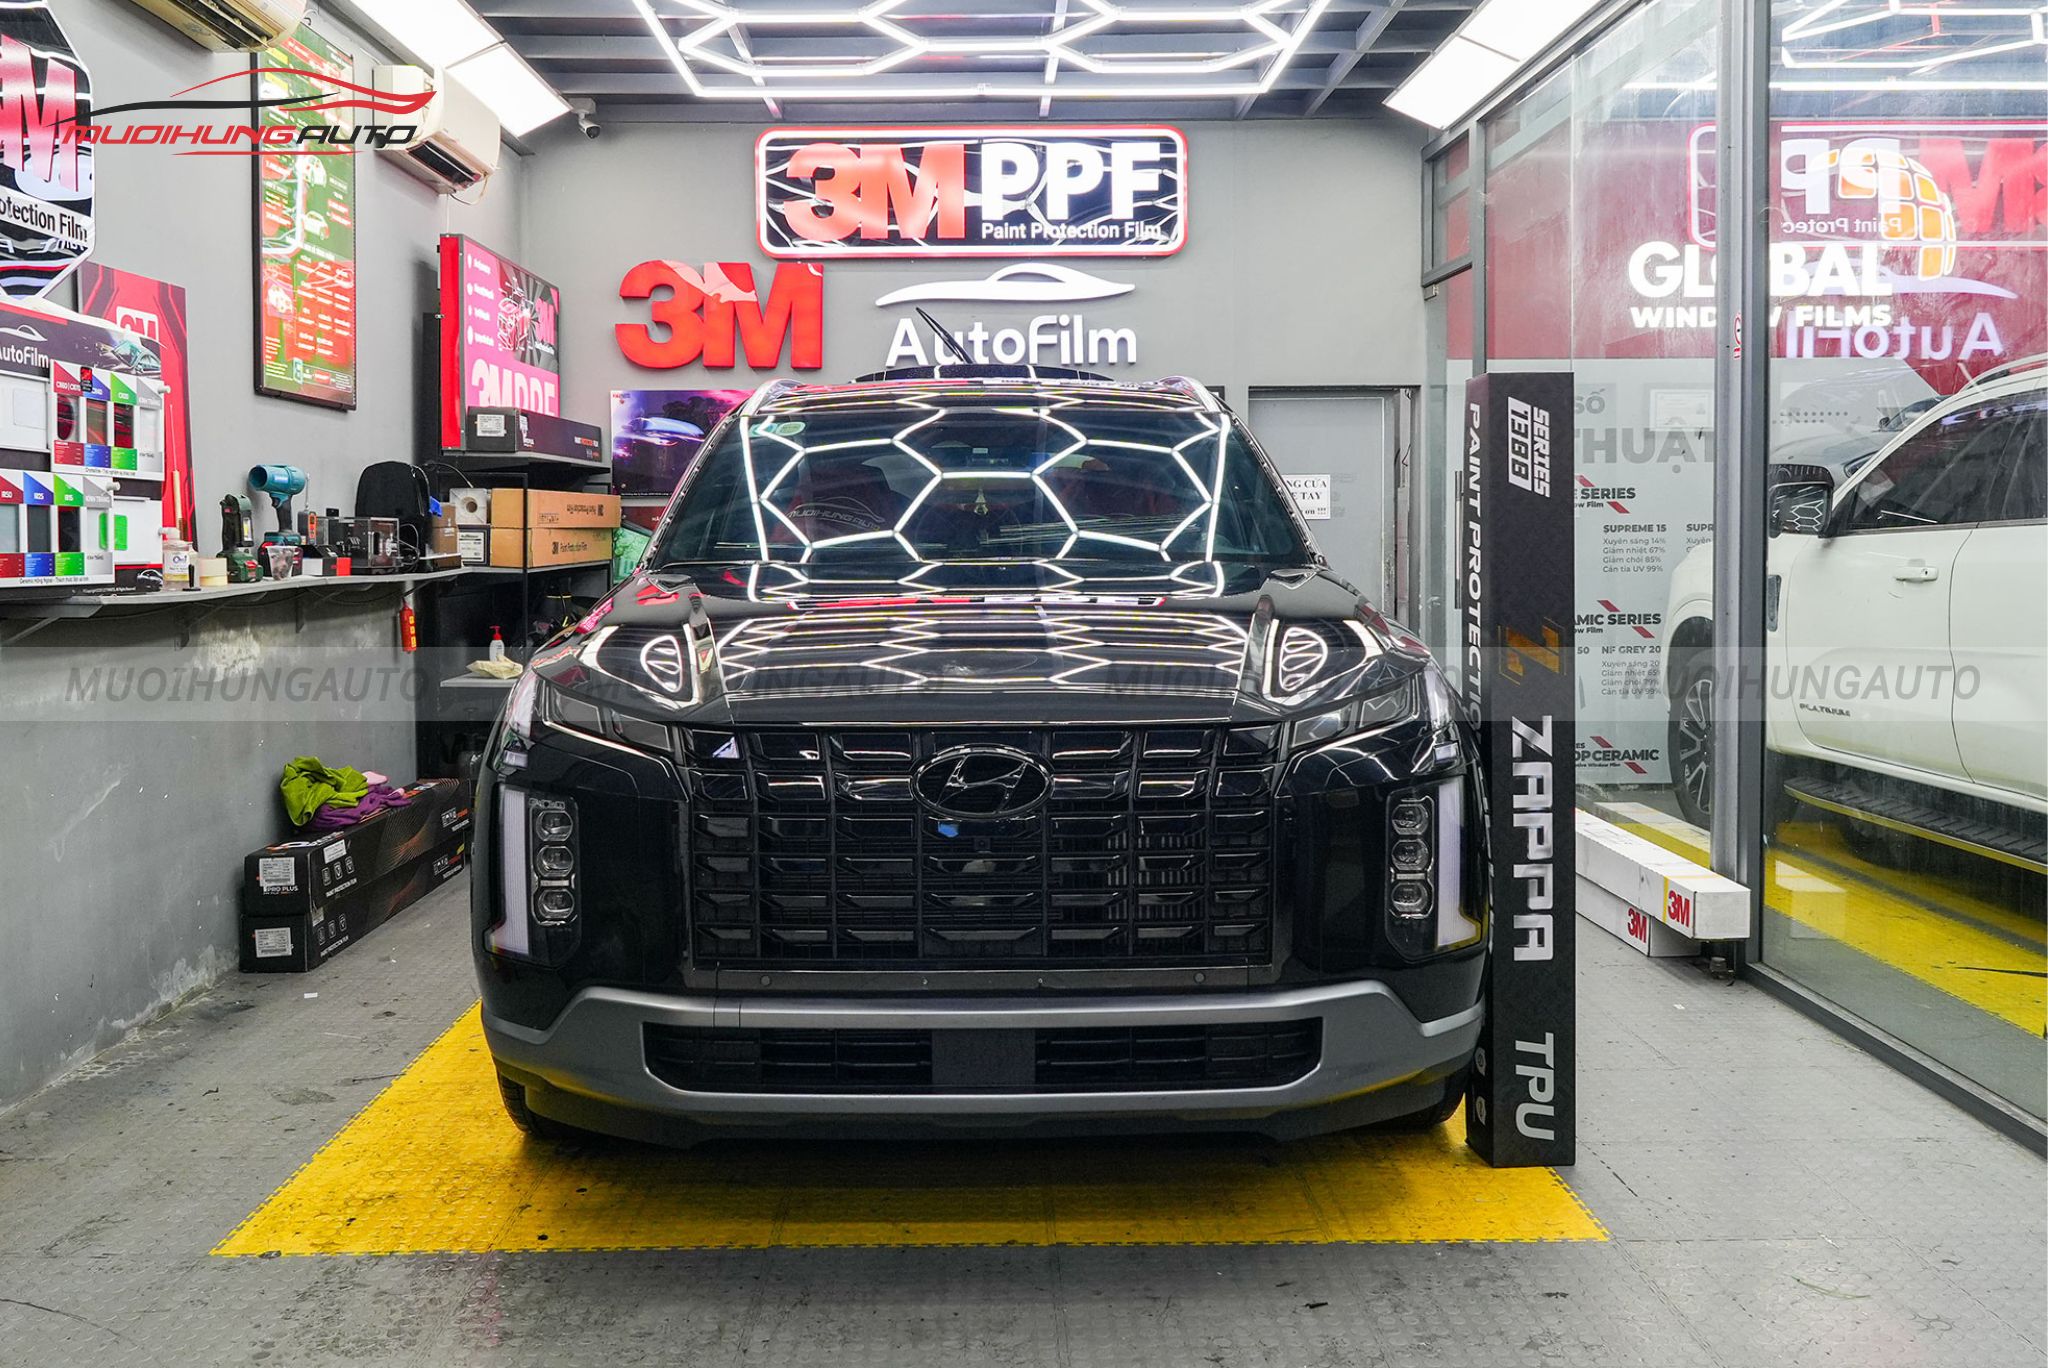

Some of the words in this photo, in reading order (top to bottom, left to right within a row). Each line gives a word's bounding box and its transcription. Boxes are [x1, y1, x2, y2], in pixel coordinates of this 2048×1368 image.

[0, 33, 78, 192] M
[783, 142, 966, 242] 3M
[981, 141, 1161, 221] PPF
[59, 212, 88, 243] Film
[981, 222, 1027, 239] Paint
[1030, 222, 1120, 239] Protection
[1124, 221, 1162, 239] Film
[1628, 241, 1893, 298] GLBAL
[615, 260, 823, 369] 3M
[1795, 304, 1892, 328] FILMS
[884, 314, 1137, 366] AutoFilm
[0, 345, 50, 368] utoFilm
[1468, 402, 1482, 517] PAINT
[1533, 406, 1551, 498] SERIES
[1580, 487, 1636, 499] SERIES
[1586, 500, 1604, 508] Film
[1603, 524, 1654, 533] SUPREME
[1656, 523, 1667, 532] 15
[1686, 523, 1714, 532] SUPR
[1467, 521, 1482, 730] PROTECTIO
[1586, 626, 1604, 634] Film
[1607, 613, 1662, 625] SERIES
[1577, 646, 1590, 655] 50
[1601, 646, 1616, 654] NF
[1618, 645, 1647, 654] GREY
[1648, 645, 1661, 654] 20
[1575, 749, 1660, 761] OPCERAMIC
[1511, 715, 1553, 961] ZAPPA
[1668, 889, 1691, 928] 3M
[1627, 907, 1647, 943] 3M
[1514, 1031, 1555, 1141] TPU
